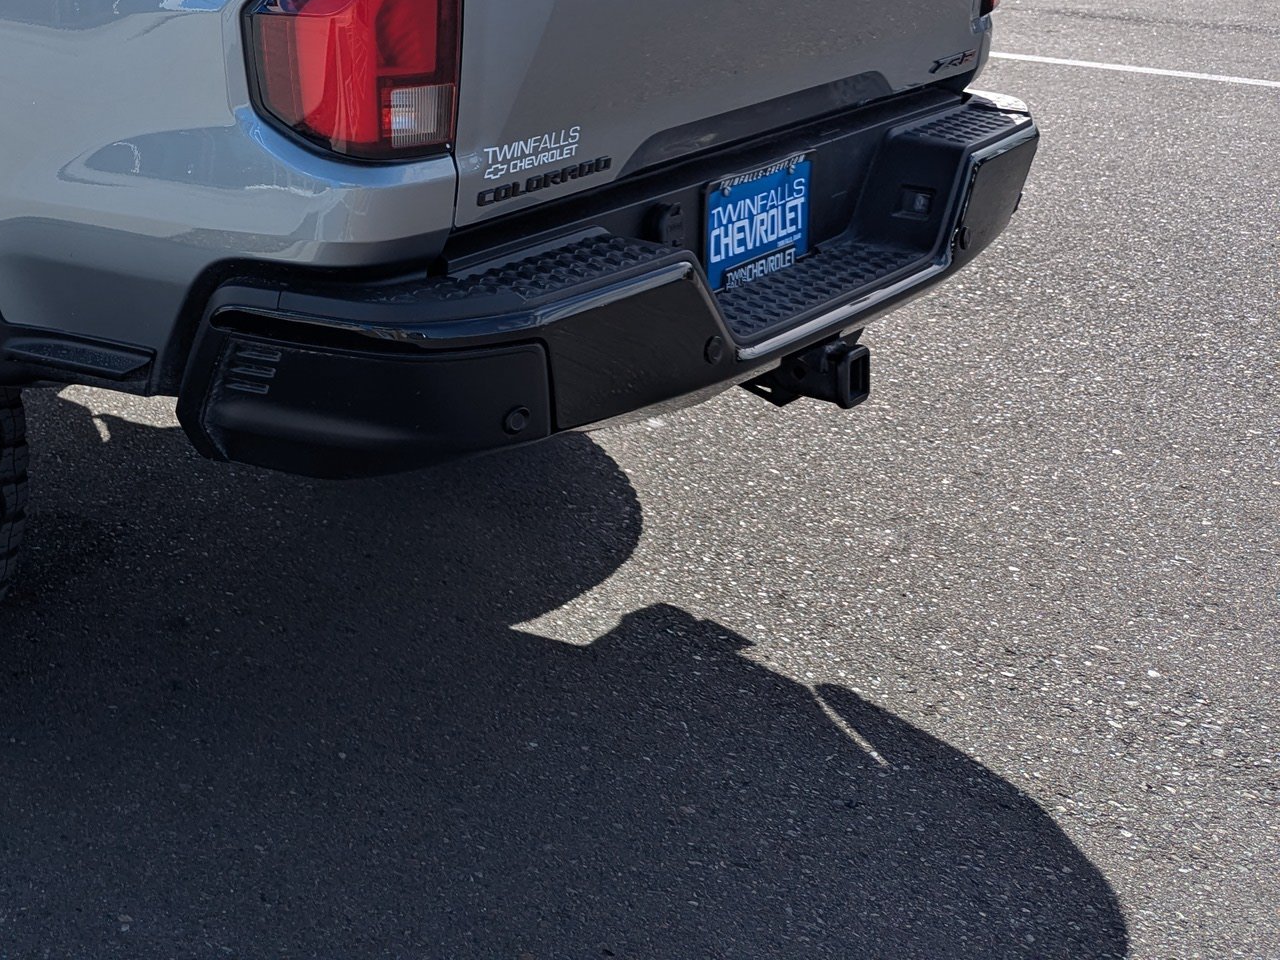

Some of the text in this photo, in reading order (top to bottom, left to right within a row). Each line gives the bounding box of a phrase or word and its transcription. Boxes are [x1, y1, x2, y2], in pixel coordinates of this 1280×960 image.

[483, 125, 581, 164] TWINFALLS
[509, 144, 579, 173] CHEVROLET
[477, 155, 612, 207] COLORADO
[710, 197, 806, 264] CHEVROLET
[746, 248, 796, 282] CHEVROLET
